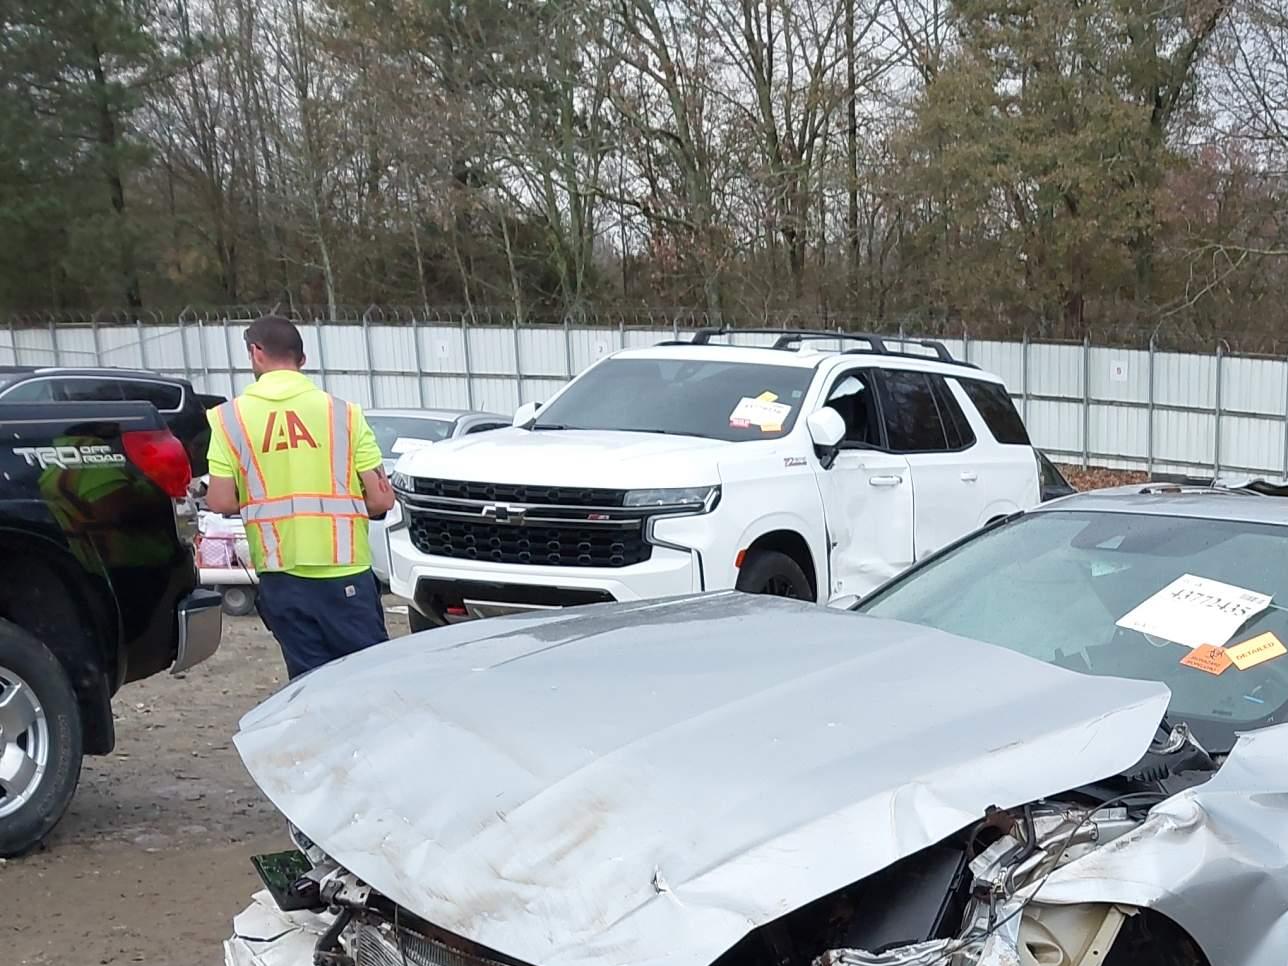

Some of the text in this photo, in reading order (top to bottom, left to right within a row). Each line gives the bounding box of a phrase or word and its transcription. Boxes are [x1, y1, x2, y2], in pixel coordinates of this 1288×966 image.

[12, 446, 82, 470] TRD
[80, 445, 113, 454] OFF
[82, 453, 126, 464] ROAD
[1171, 588, 1251, 616] 43772435
